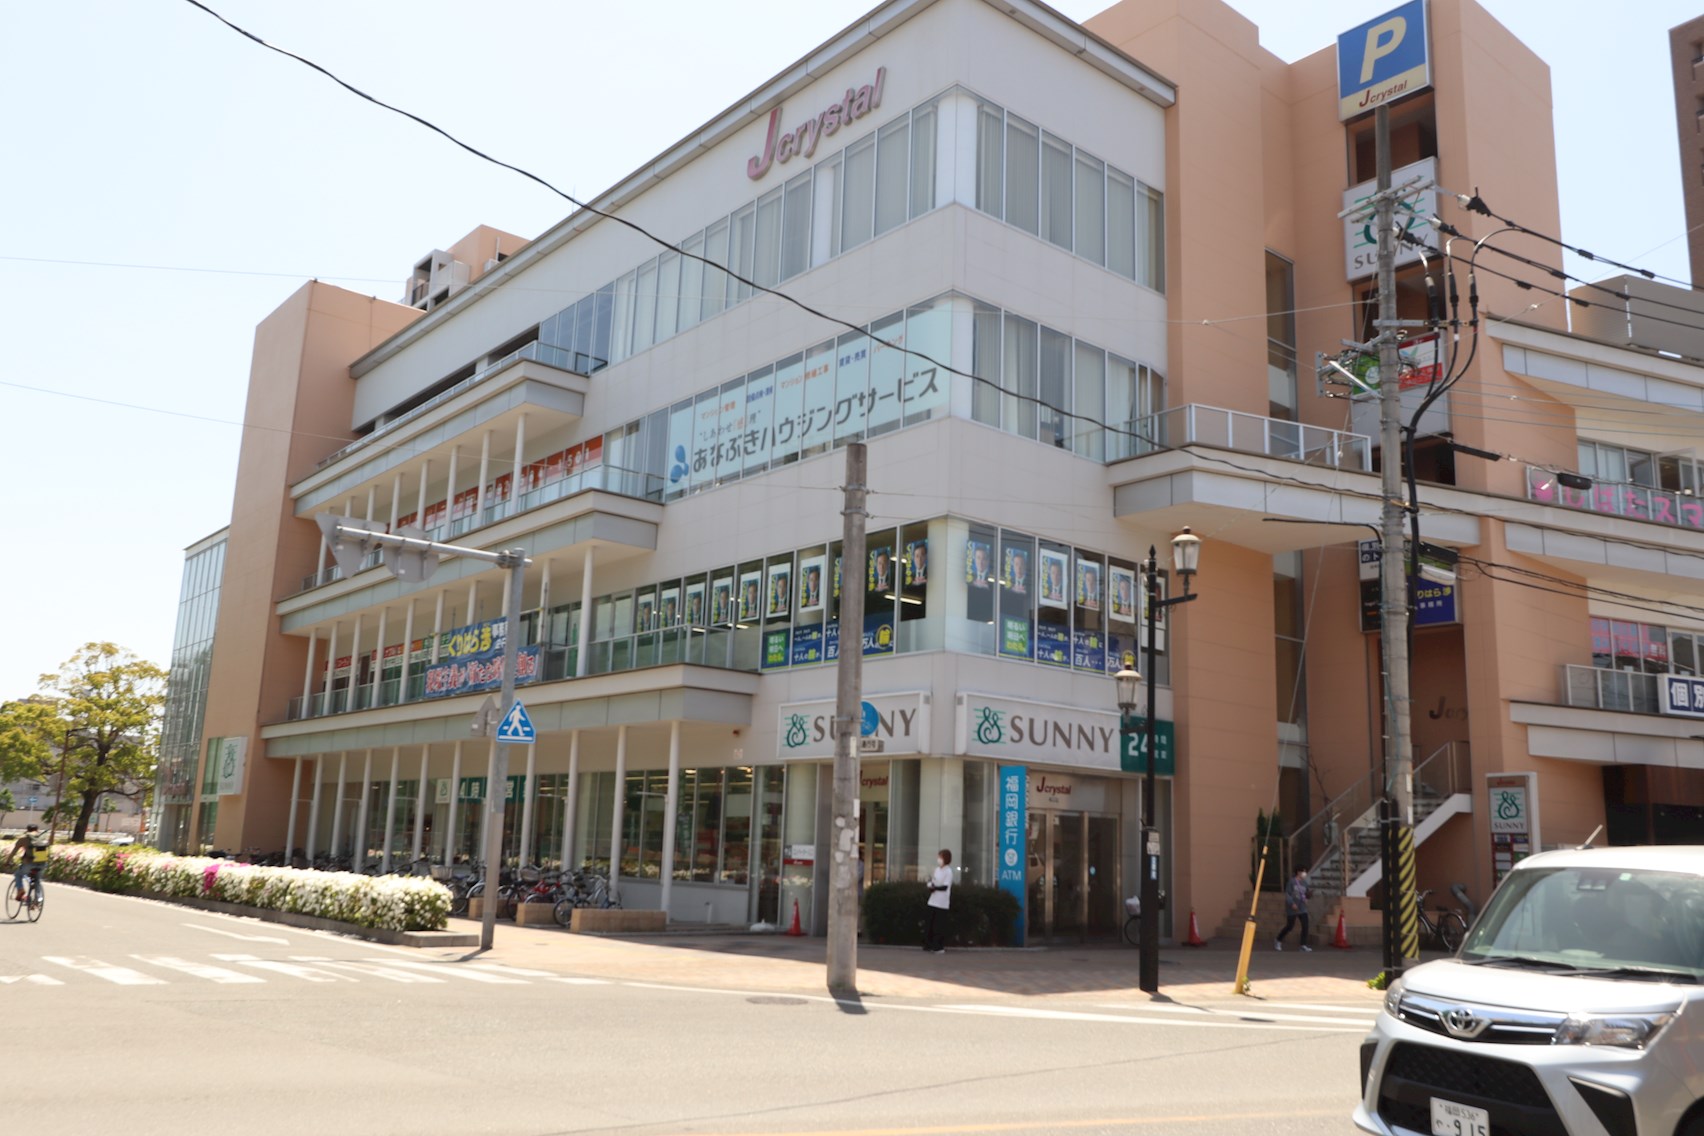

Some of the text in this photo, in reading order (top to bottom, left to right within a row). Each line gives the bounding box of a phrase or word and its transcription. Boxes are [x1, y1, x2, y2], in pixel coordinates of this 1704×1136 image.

[1360, 16, 1407, 84] P
[1359, 80, 1407, 107] Jcrystal
[747, 66, 886, 180] Jcrystal
[1354, 234, 1428, 270] SUNY
[693, 367, 938, 473] あなぶきハウジングサービス
[813, 708, 916, 742] SNY
[1010, 715, 1115, 753] SUNNY
[1037, 777, 1071, 795] Jcrystal
[1005, 775, 1019, 845] 福岡銀行
[1001, 870, 1022, 880] ATM
